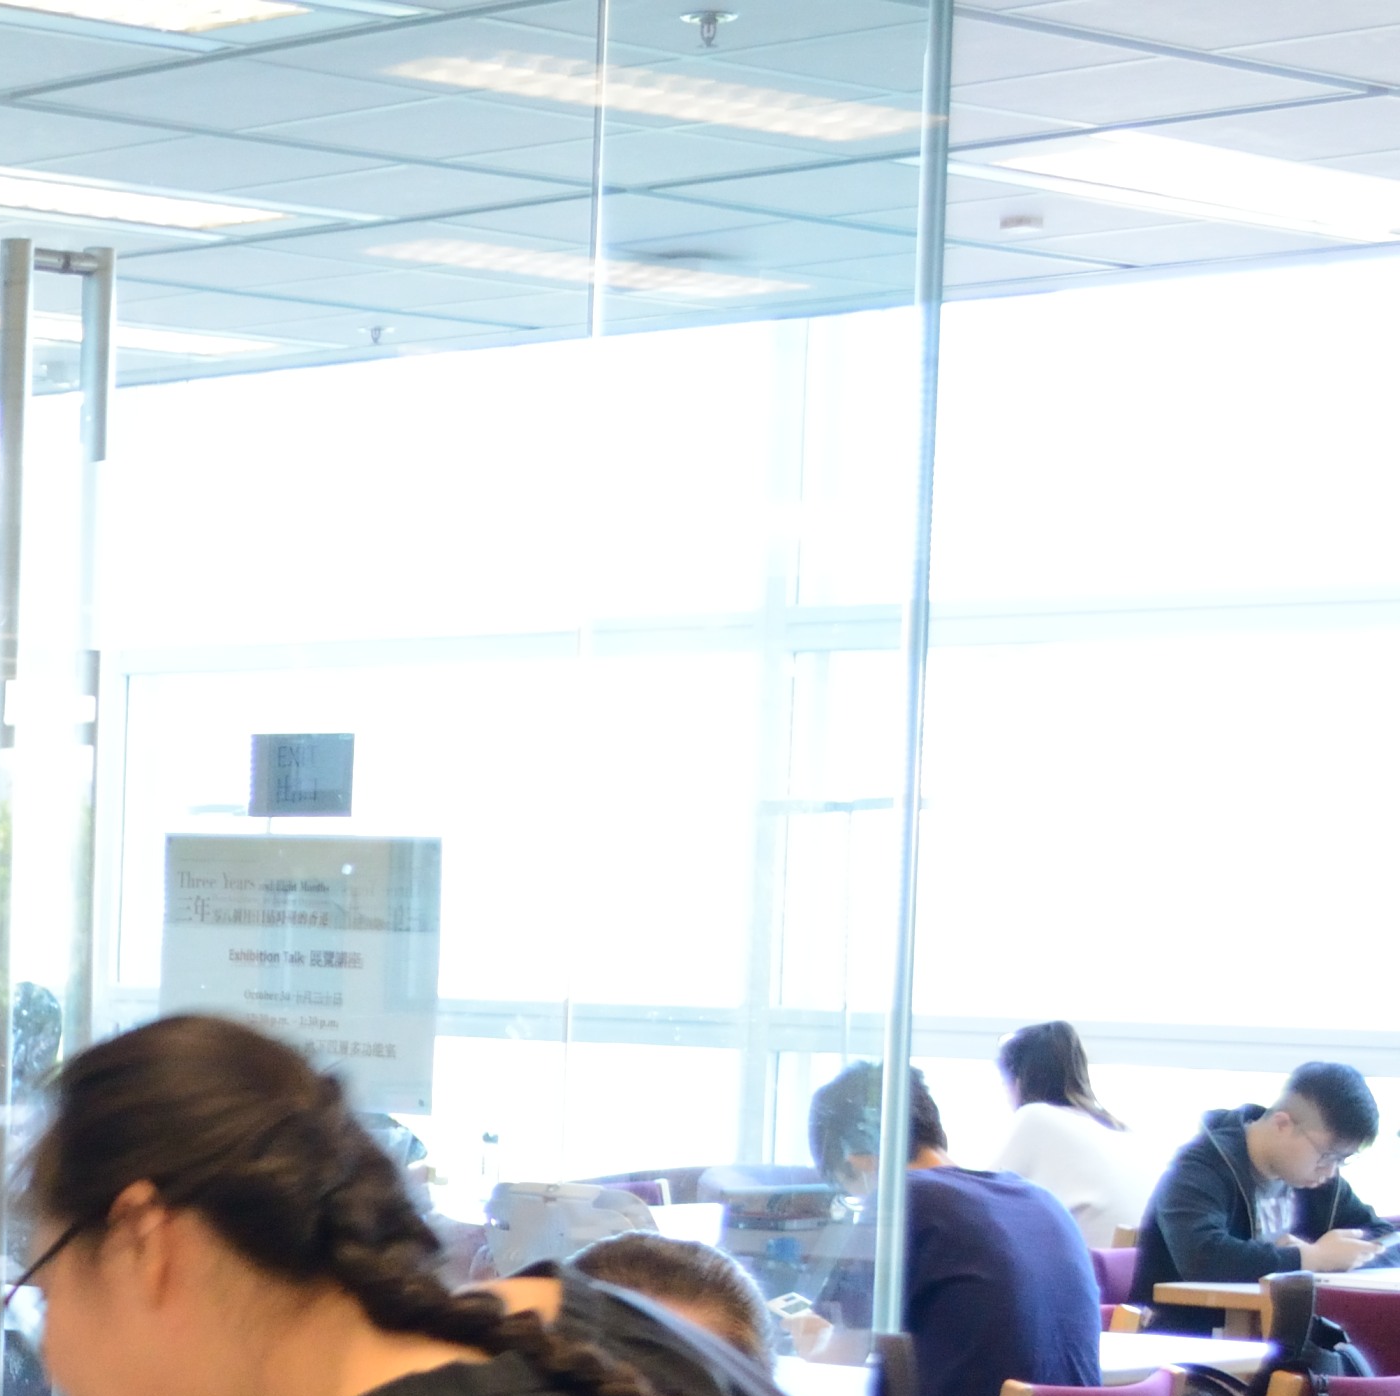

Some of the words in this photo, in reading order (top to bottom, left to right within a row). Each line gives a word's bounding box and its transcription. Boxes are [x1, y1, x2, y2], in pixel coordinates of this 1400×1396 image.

[177, 871, 216, 889] Three
[222, 872, 254, 890] Years
[228, 949, 280, 964] Exhibition
[283, 951, 305, 964] Talk
[244, 989, 279, 1002] October
